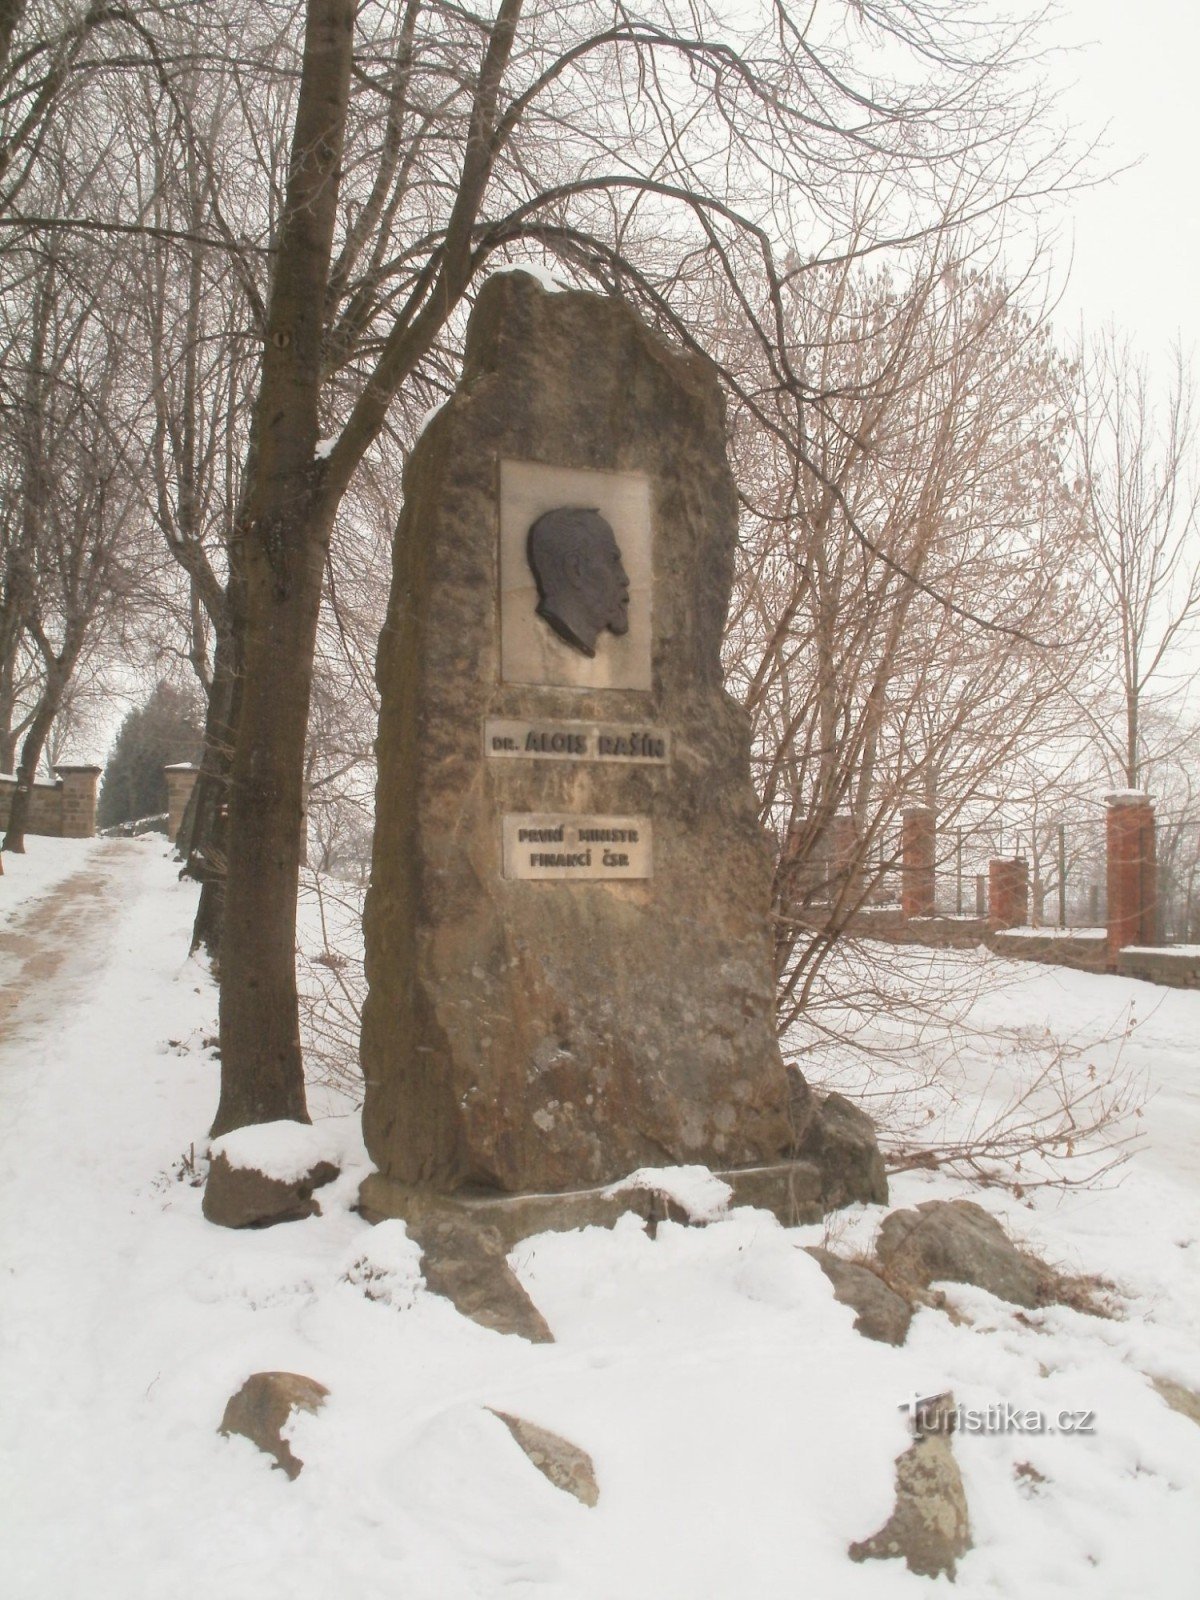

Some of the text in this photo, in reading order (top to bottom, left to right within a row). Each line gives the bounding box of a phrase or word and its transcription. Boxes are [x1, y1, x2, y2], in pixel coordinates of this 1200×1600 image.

[492, 730, 665, 758] DR. ALOIS RAŠÍN
[518, 824, 639, 844] PRVNÍ MINISTR
[530, 848, 630, 867] FINANCÍ ČSR
